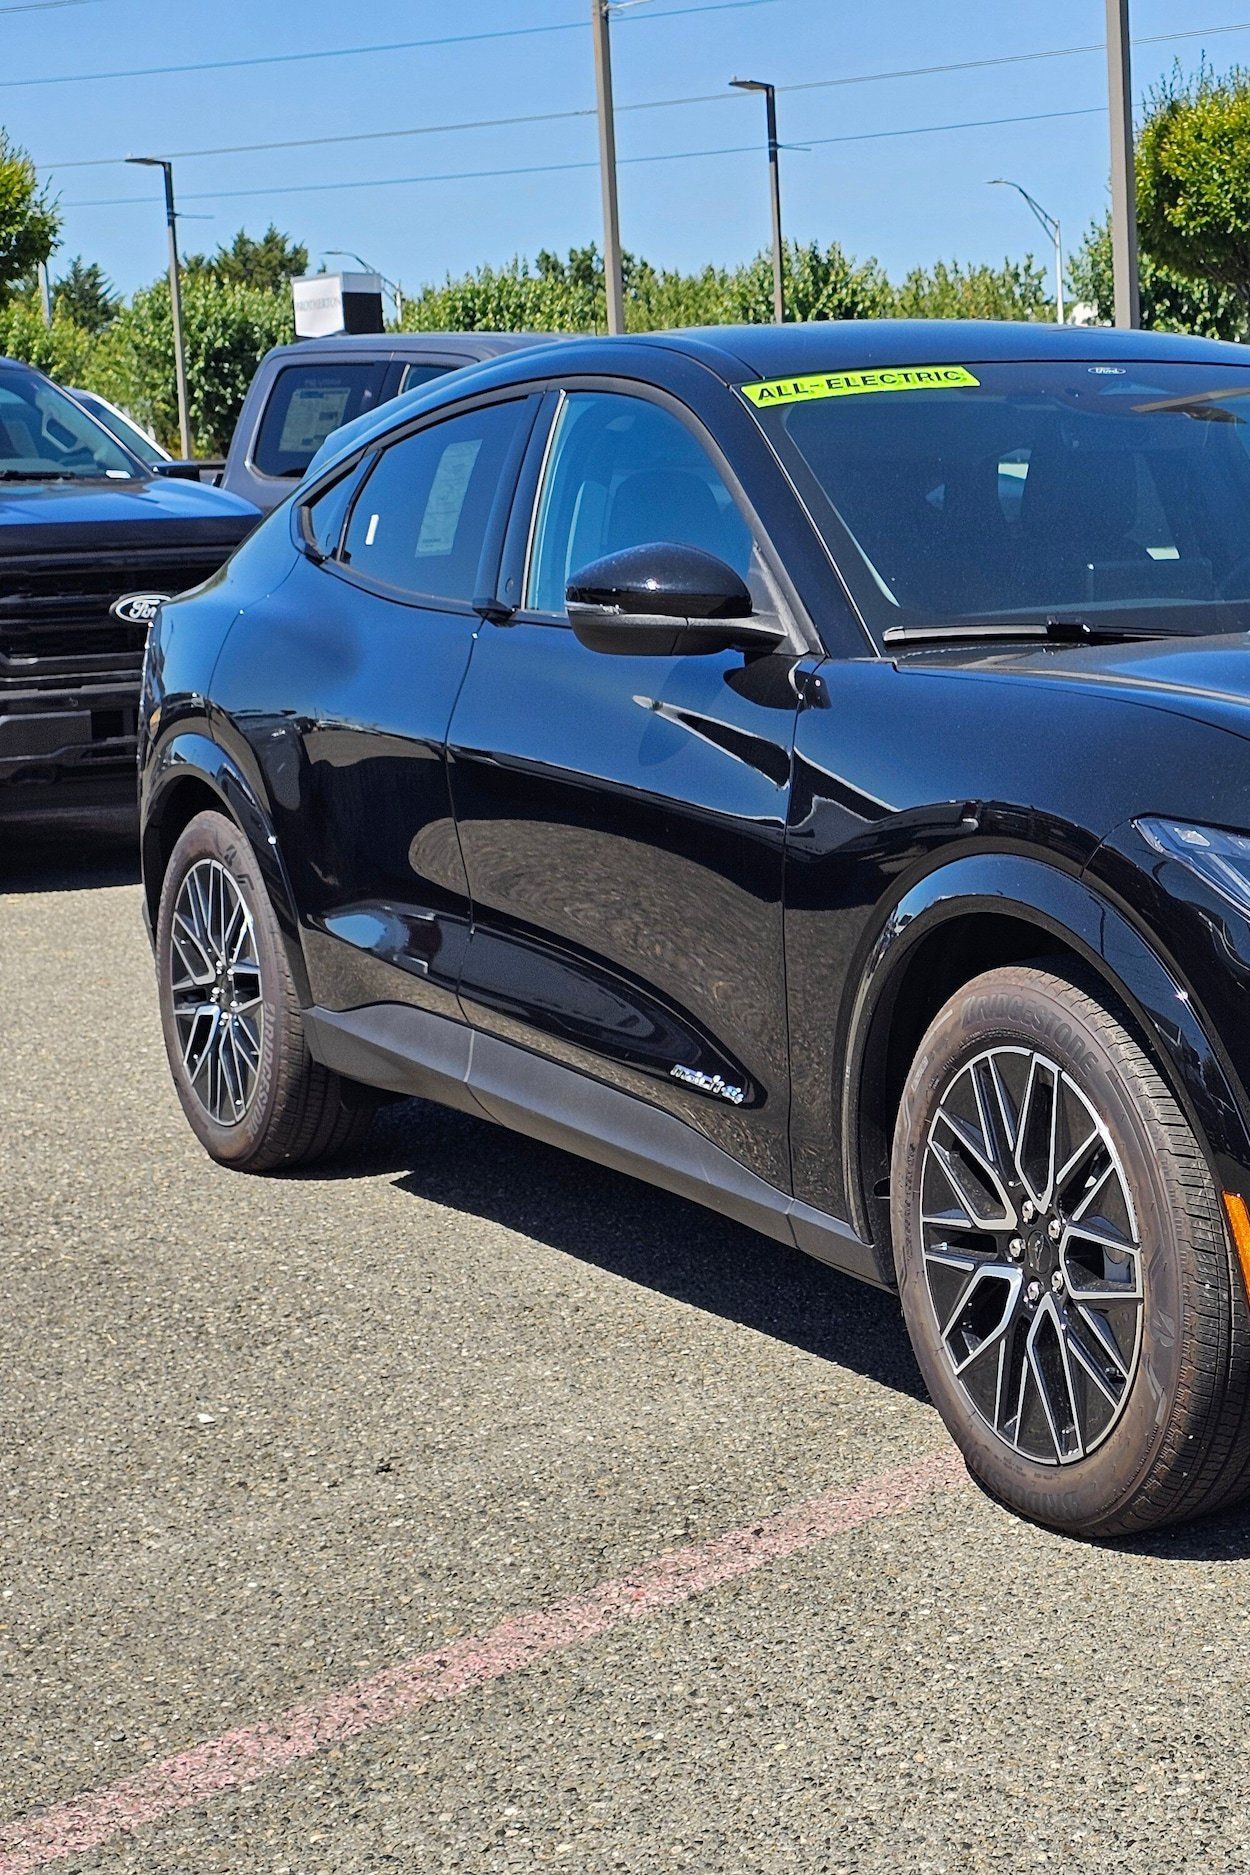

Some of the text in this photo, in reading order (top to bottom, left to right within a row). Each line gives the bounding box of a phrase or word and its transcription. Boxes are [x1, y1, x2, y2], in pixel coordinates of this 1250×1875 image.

[757, 370, 963, 401] ALL-ELECTRIC
[129, 599, 161, 619] For
[961, 992, 1099, 1077] BRIDGESTONE
